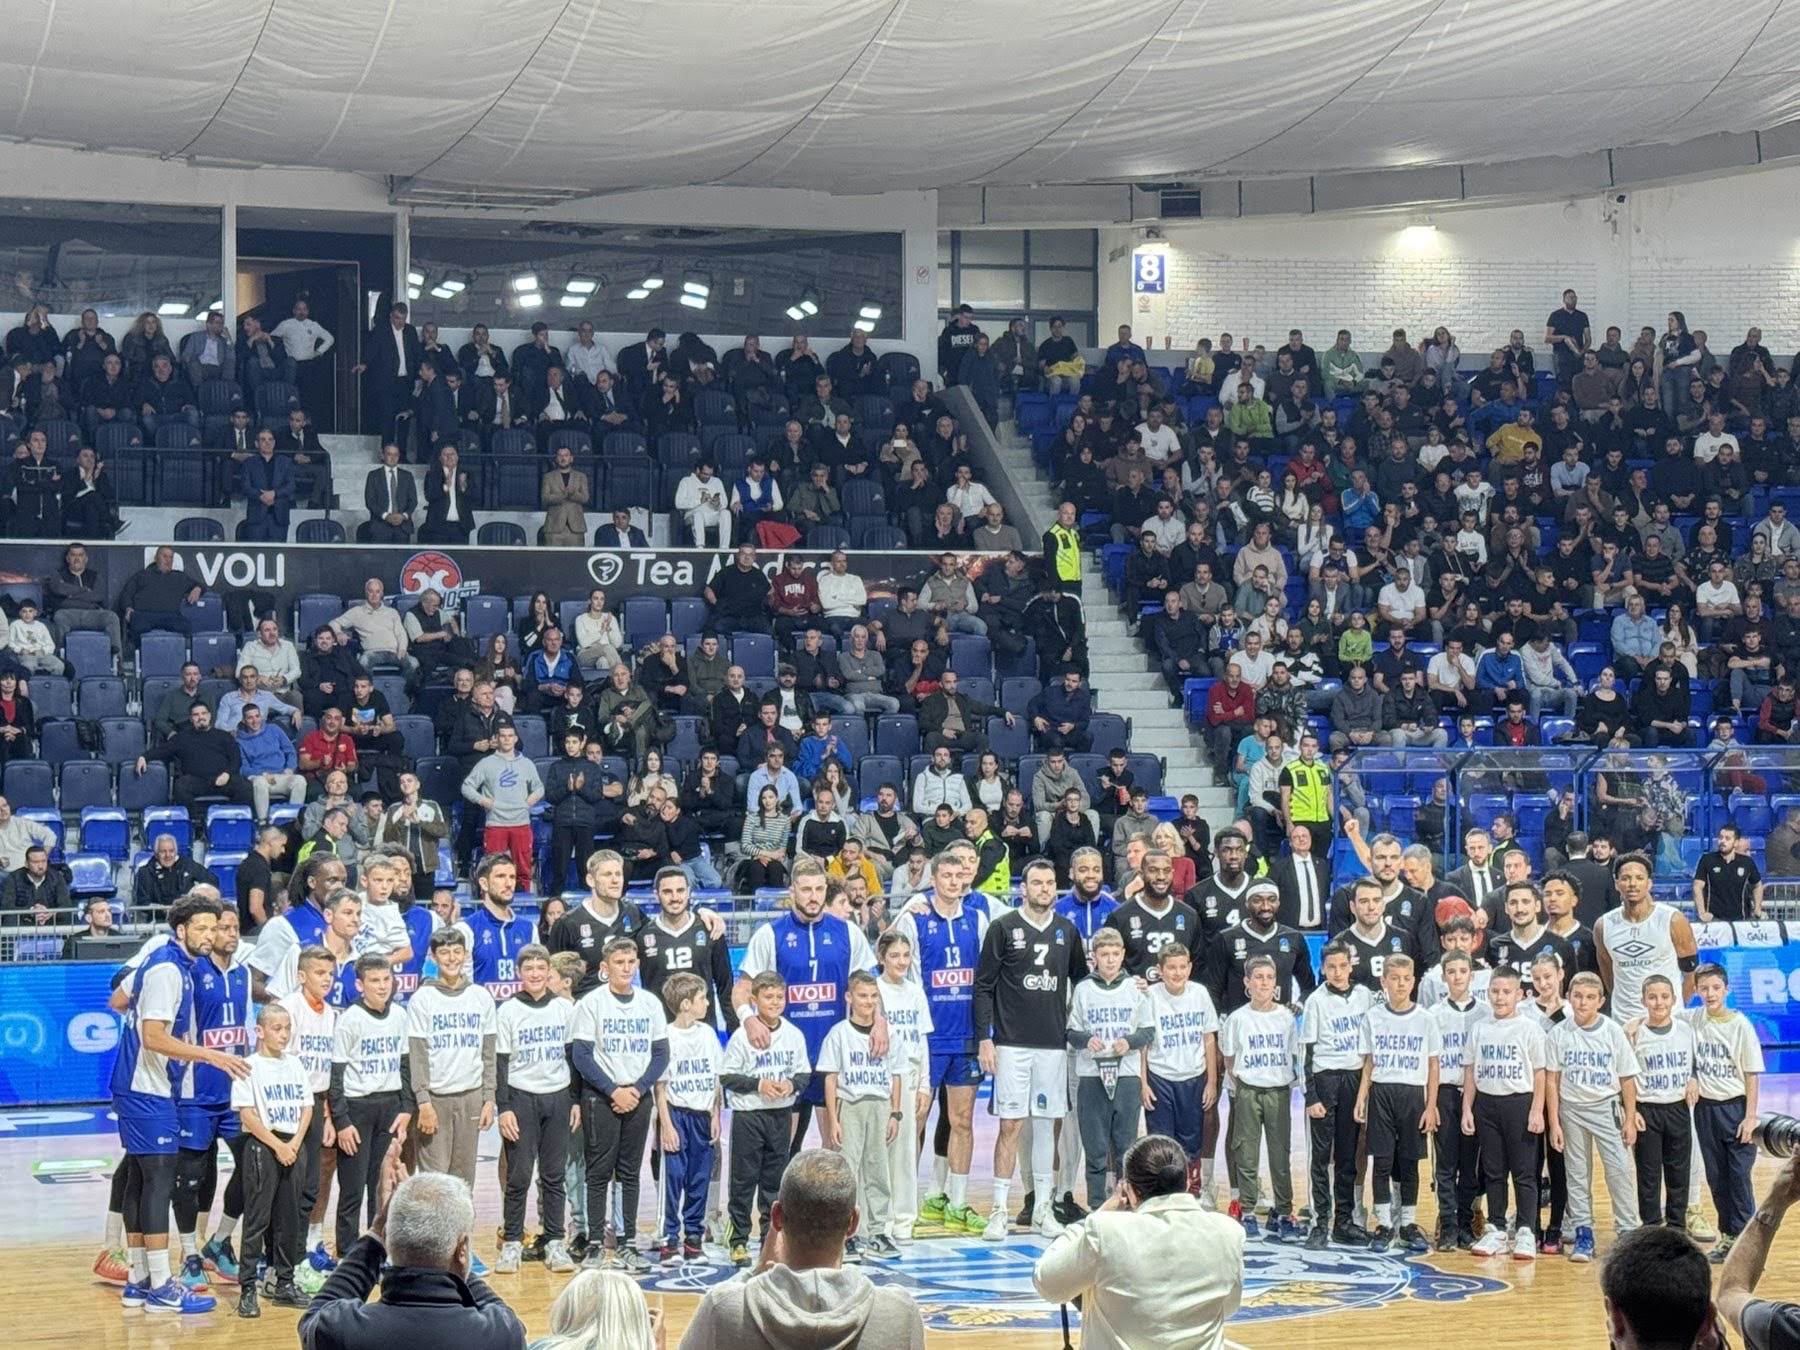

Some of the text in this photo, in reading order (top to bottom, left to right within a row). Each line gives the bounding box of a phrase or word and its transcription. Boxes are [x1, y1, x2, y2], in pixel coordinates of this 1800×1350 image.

[1140, 255, 1160, 281] 8
[196, 552, 285, 588] VOLI
[630, 553, 694, 586] Tea
[665, 946, 692, 970] 12
[944, 946, 961, 967] 13
[1033, 944, 1049, 965] 7
[498, 959, 513, 980] 83
[809, 960, 818, 982] 7
[936, 970, 970, 985] VOLI
[1023, 969, 1058, 991] GAIN
[792, 986, 832, 1001] VOLI
[222, 1002, 235, 1025] 11
[433, 1013, 481, 1030] PEACE IS NOT
[603, 1018, 624, 1034] PEACE
[635, 1018, 650, 1034] NOT
[1160, 1015, 1184, 1030] PEACE
[1332, 1017, 1349, 1033] MIR
[453, 1034, 458, 1047] A
[519, 1027, 544, 1045] PEACE
[551, 1025, 565, 1041] NOT
[1162, 1035, 1179, 1048] JUST
[1182, 1034, 1187, 1046] A
[1249, 1035, 1264, 1050] MIR
[1375, 1035, 1423, 1051] PEACE IS NOT
[1444, 1034, 1460, 1047] MIR
[623, 1039, 628, 1053] A
[630, 1039, 649, 1053] WORD
[1481, 1044, 1517, 1060] MIR NIJE
[537, 1048, 543, 1062] A
[774, 1051, 795, 1067] NIJE
[1244, 1054, 1268, 1069] SAMO
[1644, 1051, 1687, 1071] MIR NIJE
[692, 1058, 711, 1074] NIJE
[1399, 1056, 1420, 1071] WORD
[1497, 1062, 1523, 1080] RIJEČ
[670, 1080, 696, 1093] SAMO
[845, 1071, 869, 1086] SAMO
[1590, 1072, 1612, 1086] WORD
[263, 1084, 283, 1101] MIR
